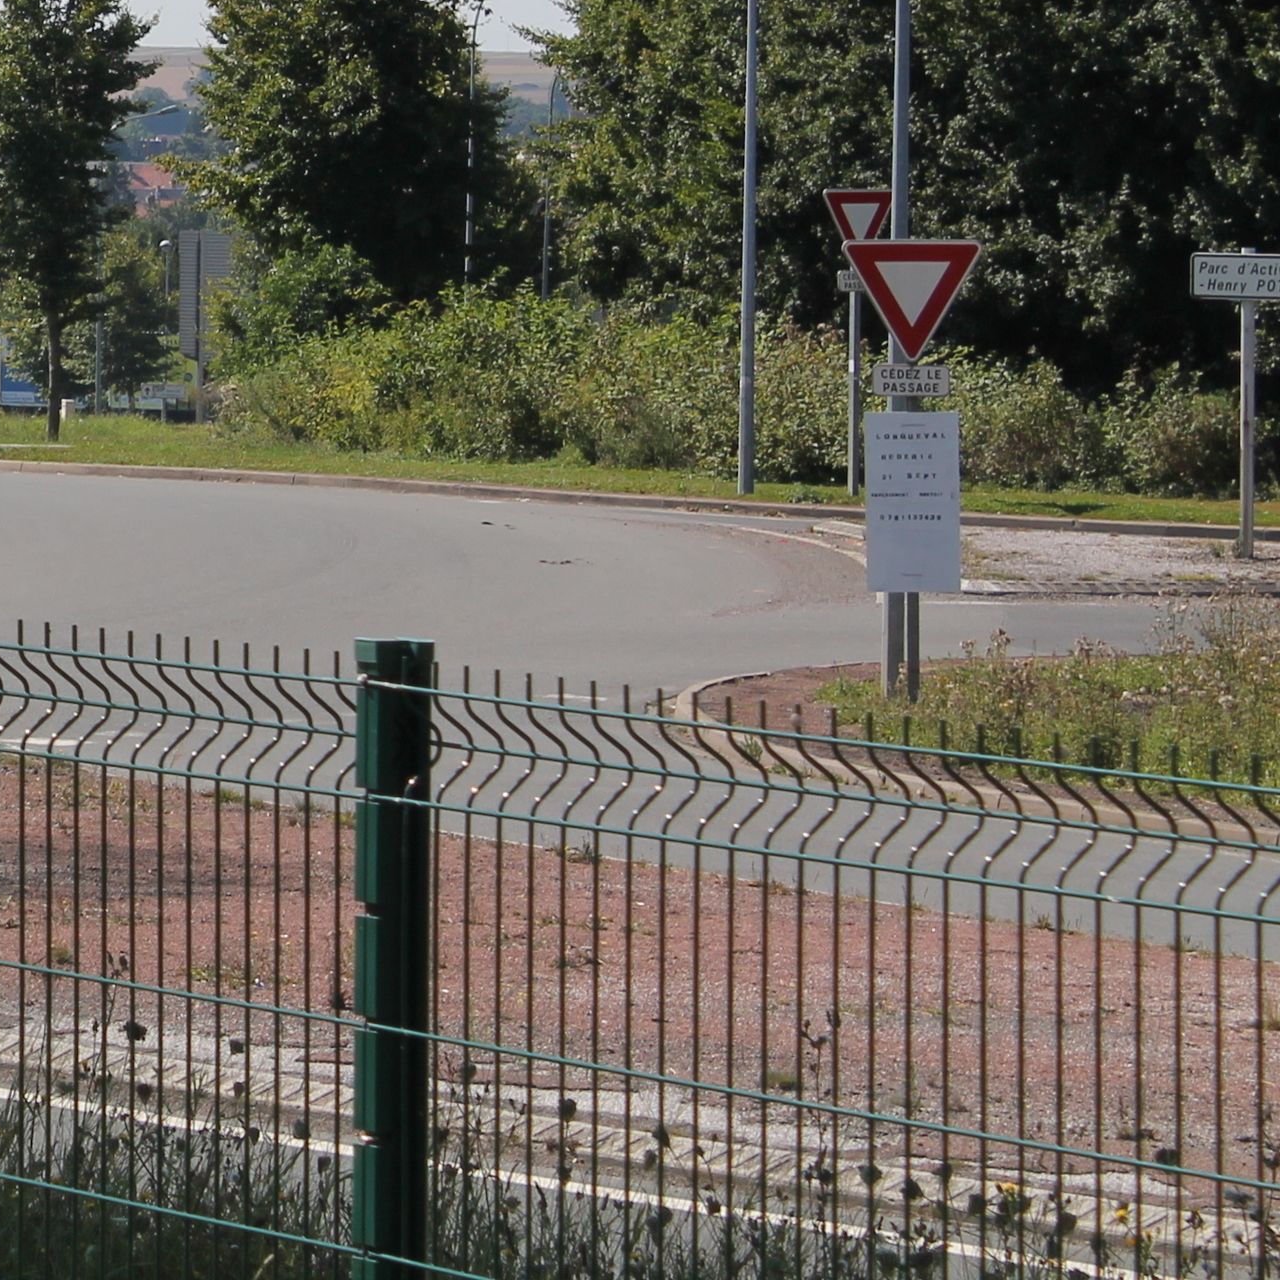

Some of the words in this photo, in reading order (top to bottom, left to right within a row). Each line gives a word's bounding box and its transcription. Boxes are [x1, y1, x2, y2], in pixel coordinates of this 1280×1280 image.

[1199, 261, 1228, 274] Parc
[1238, 262, 1280, 276] d'Acti
[880, 367, 920, 380] CÉDEZ
[927, 369, 942, 380] LE
[883, 382, 939, 393] PASSAGE
